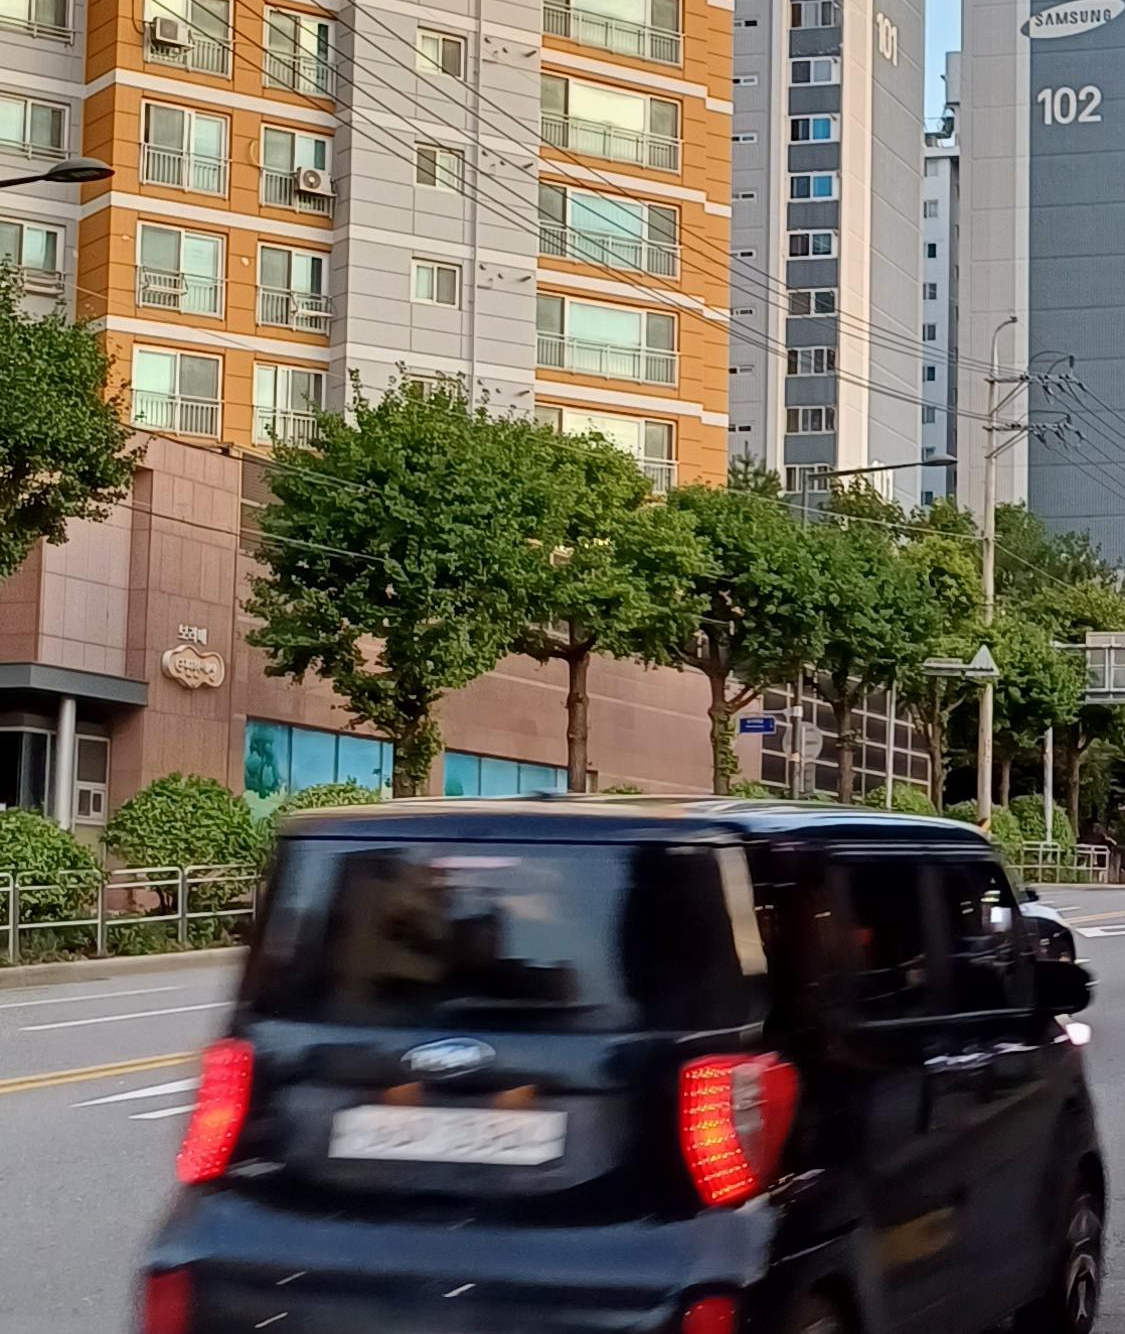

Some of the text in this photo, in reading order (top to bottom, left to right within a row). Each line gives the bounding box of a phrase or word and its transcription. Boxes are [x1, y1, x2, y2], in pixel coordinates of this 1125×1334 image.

[1034, 8, 1112, 28] SAMSUNG
[876, 11, 898, 67] 101
[1036, 84, 1102, 125] 102
[178, 624, 207, 645] 보라매
